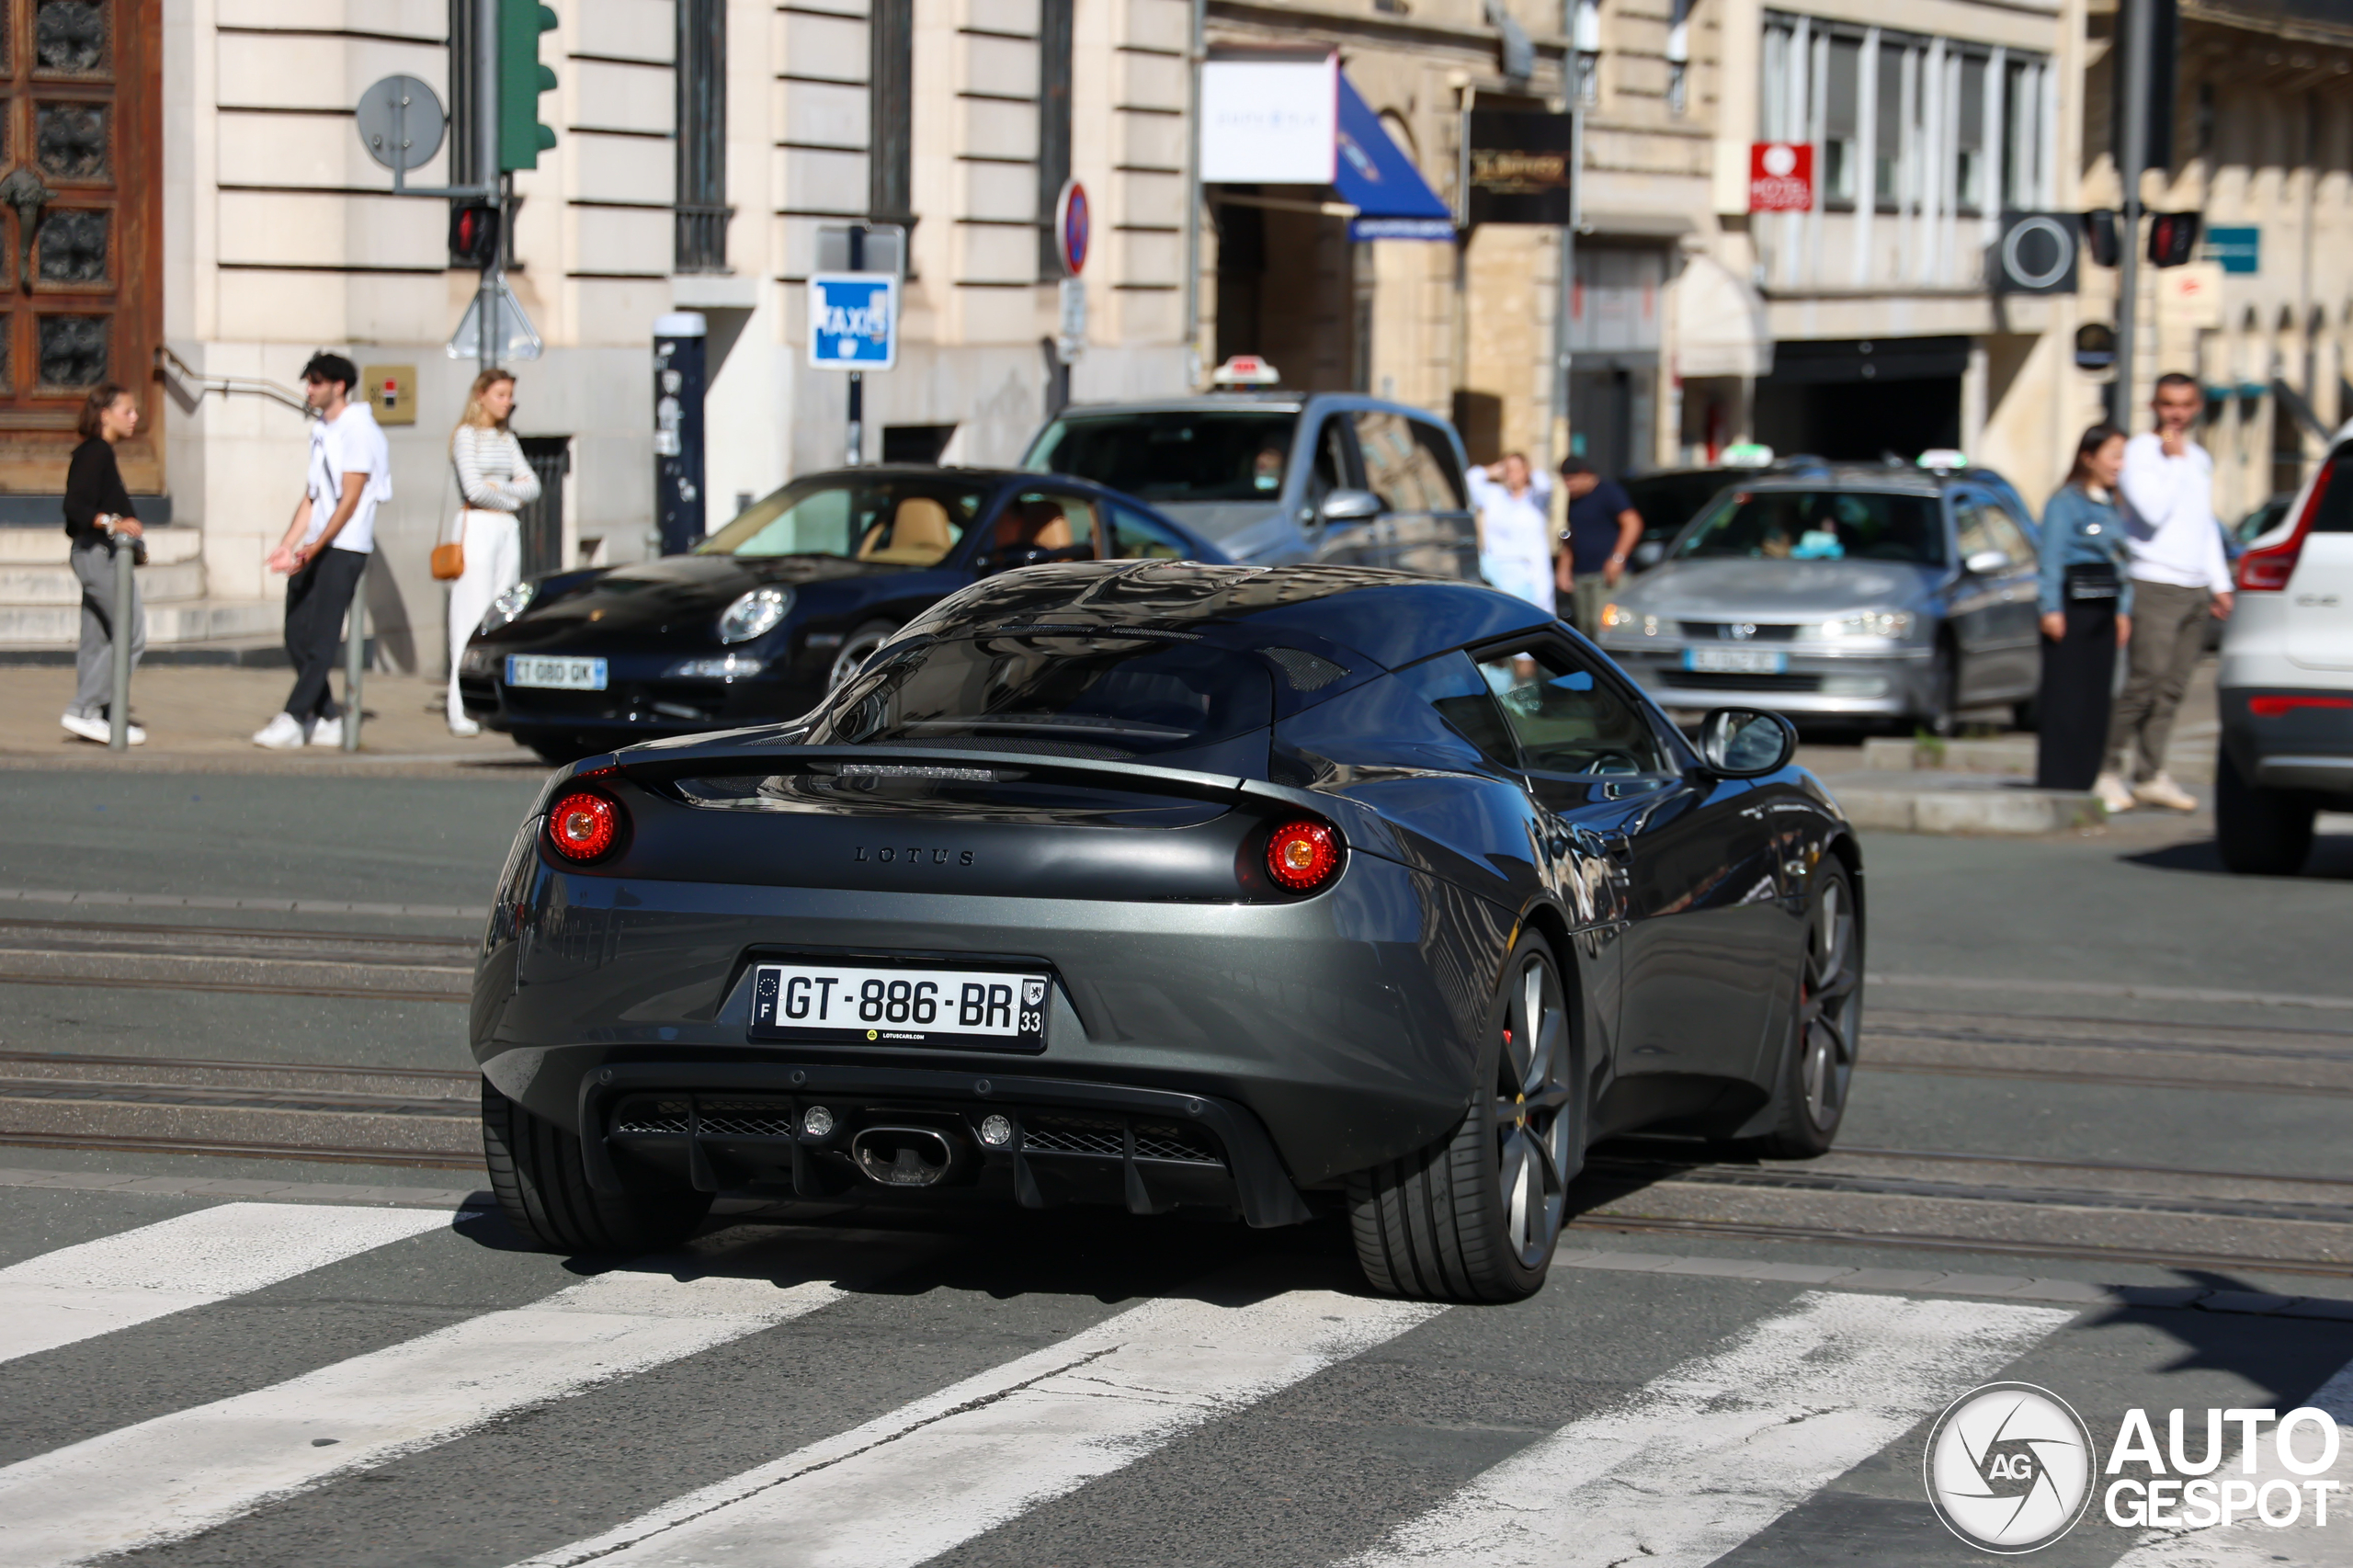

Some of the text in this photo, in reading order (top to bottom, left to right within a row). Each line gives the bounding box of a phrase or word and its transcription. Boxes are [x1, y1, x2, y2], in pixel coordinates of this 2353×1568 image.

[854, 846, 975, 866] LOTUS
[760, 1003, 770, 1018] F
[785, 976, 1013, 1028] GT-886-BR
[1020, 1011, 1041, 1032] 33
[882, 1032, 925, 1040] LOTUSCARS.COM
